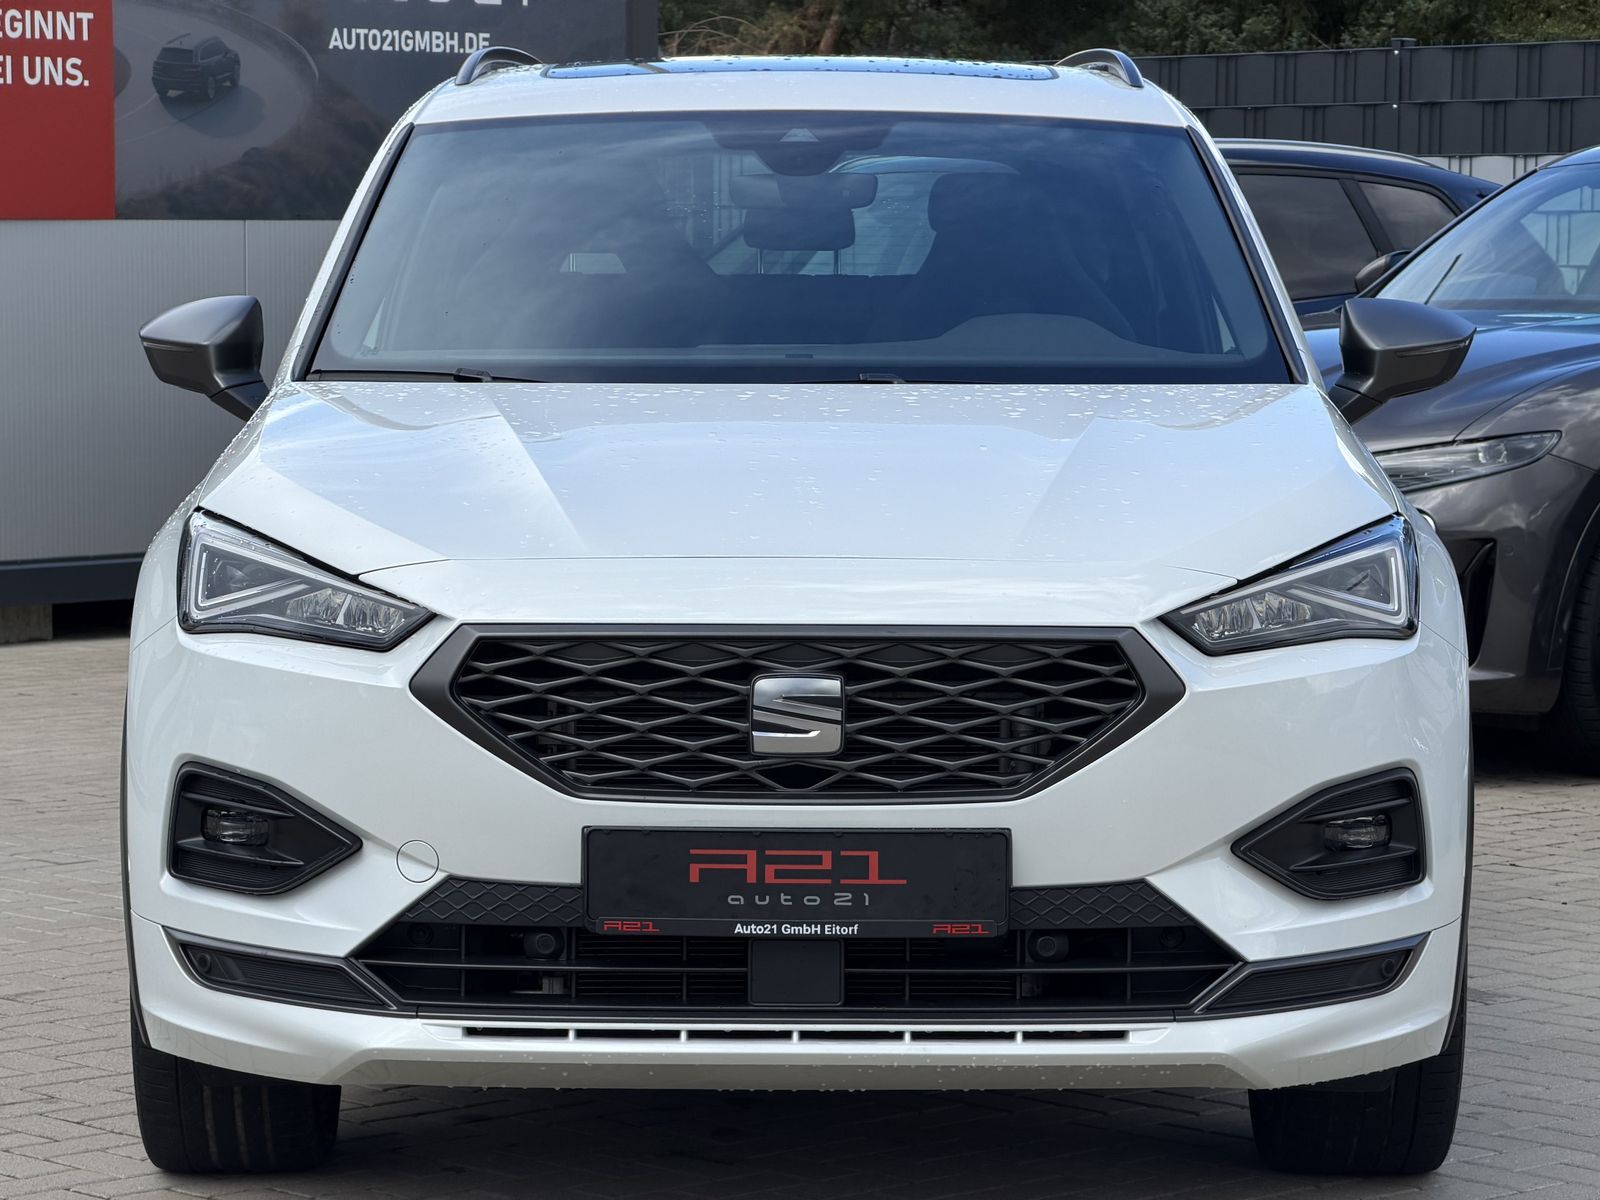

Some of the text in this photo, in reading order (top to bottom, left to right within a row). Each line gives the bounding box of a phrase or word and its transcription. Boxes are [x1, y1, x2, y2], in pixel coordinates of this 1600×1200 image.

[0, 8, 94, 41] GINNT
[328, 27, 491, 54] AUTO21GMBH.DE
[23, 55, 90, 86] UNS.
[689, 848, 908, 885] A21
[727, 892, 870, 906] auto21
[603, 920, 660, 932] A21
[734, 923, 859, 936] Auto21 GmbH Eitorf
[932, 923, 990, 935] A21
